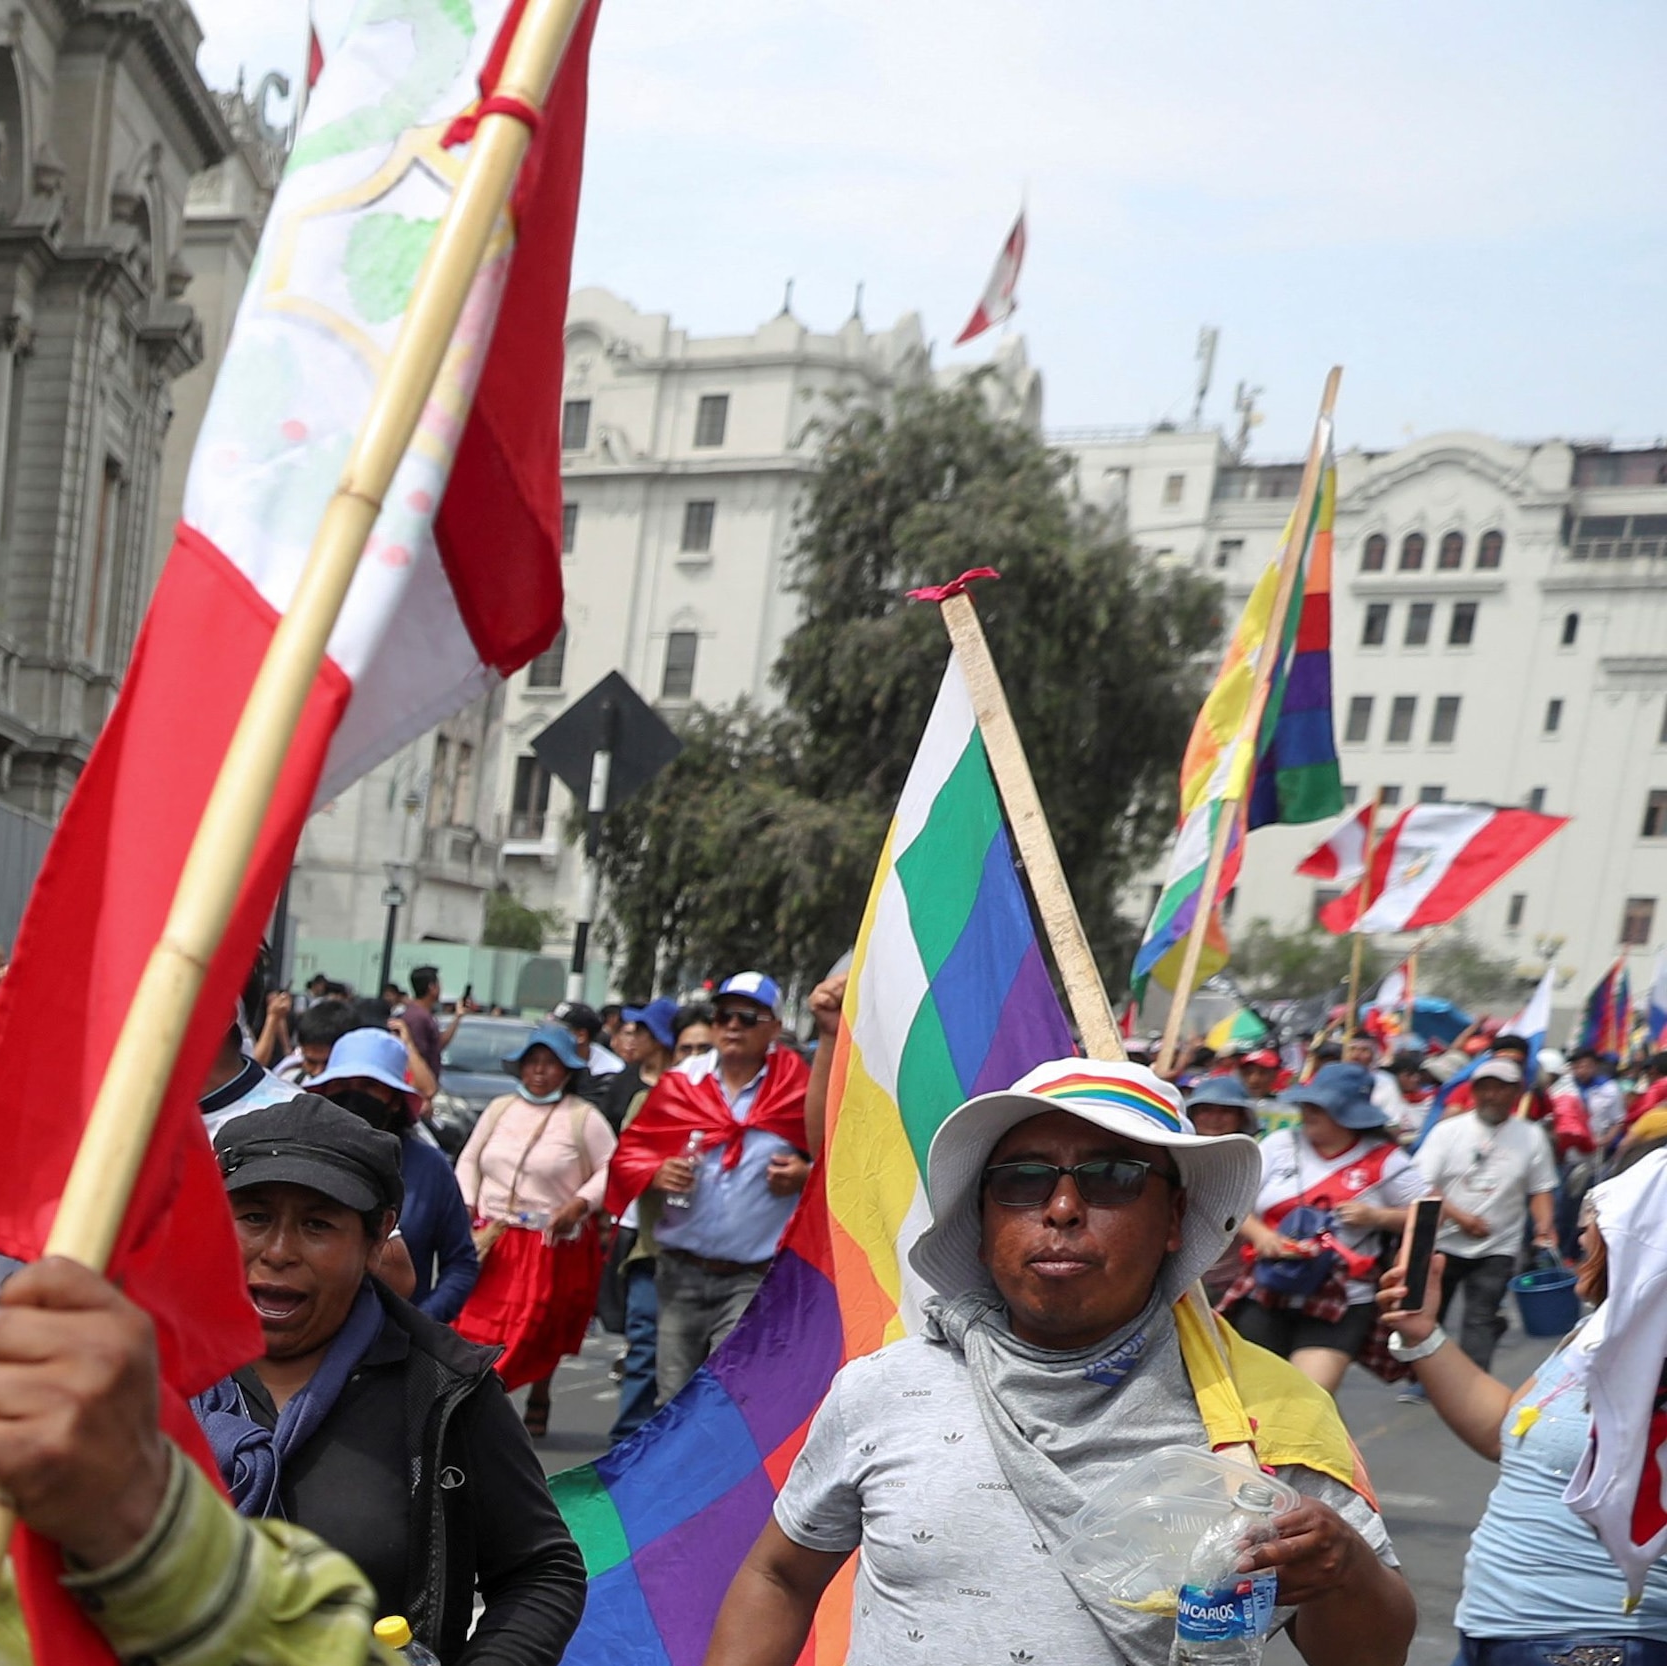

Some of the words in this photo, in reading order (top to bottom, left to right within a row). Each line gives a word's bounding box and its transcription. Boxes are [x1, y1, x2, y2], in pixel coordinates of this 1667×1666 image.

[902, 1389, 931, 1398] adidas
[977, 1481, 1012, 1491] adidas
[957, 1586, 991, 1598] adidas
